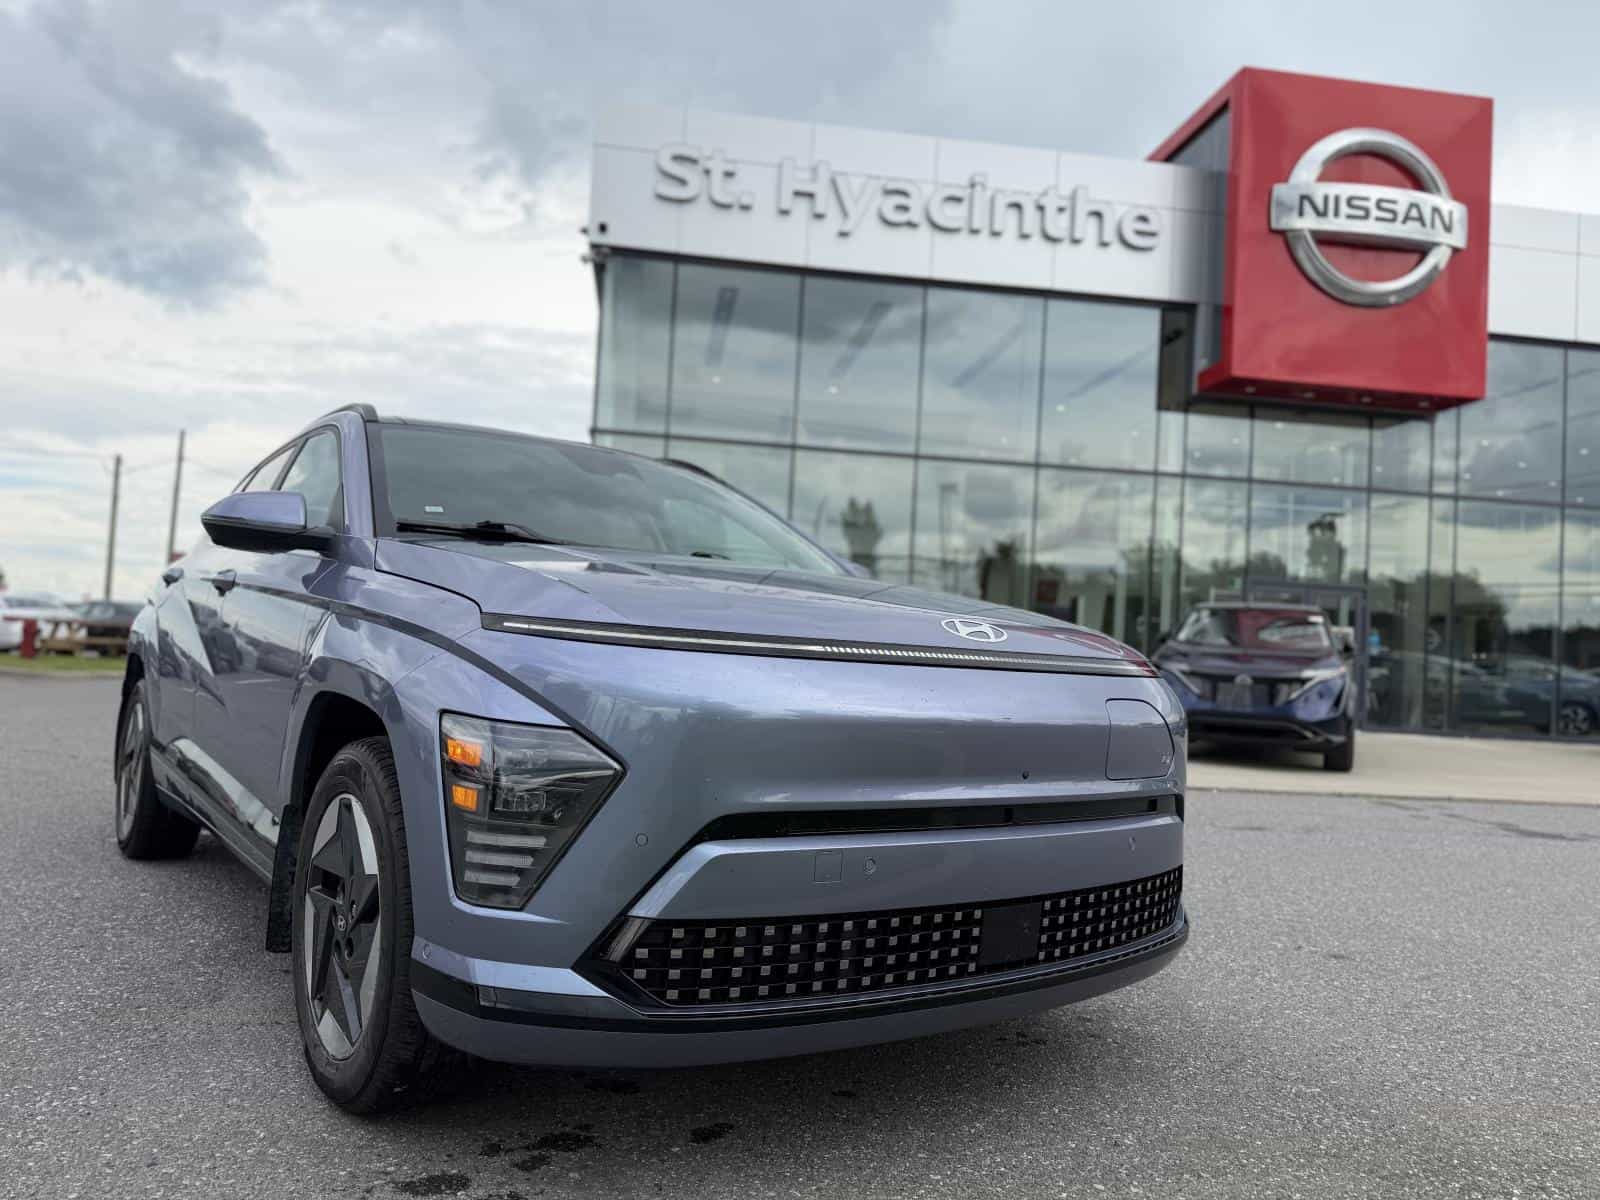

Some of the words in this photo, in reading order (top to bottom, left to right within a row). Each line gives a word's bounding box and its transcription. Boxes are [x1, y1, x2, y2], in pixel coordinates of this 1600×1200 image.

[655, 144, 753, 210] St.
[777, 159, 1161, 252] Hyacinthe
[1298, 194, 1454, 233] NISSAN
